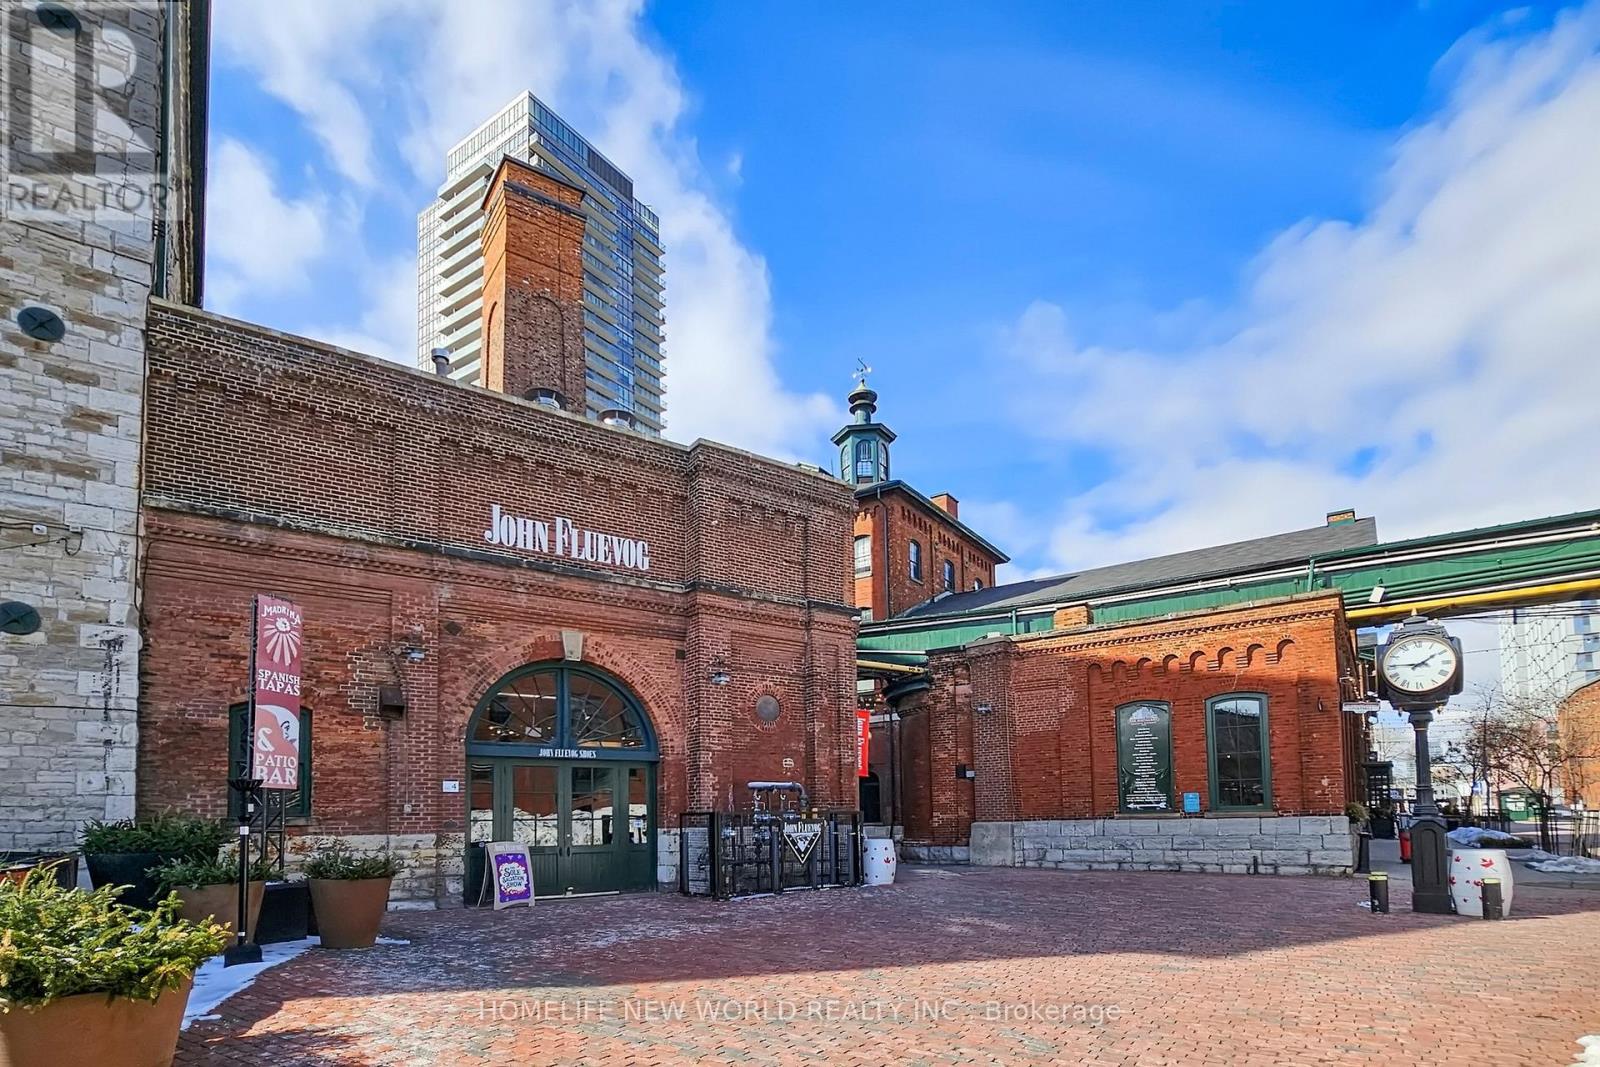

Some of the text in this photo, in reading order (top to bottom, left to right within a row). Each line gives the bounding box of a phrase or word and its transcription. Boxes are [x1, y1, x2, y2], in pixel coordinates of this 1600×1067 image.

[485, 504, 650, 570] JOHN FLUEVOG
[258, 669, 300, 685] SPANISH
[258, 678, 300, 696] TAPAS
[257, 727, 275, 752] &
[256, 753, 297, 768] PATIO
[255, 766, 297, 785] BAR
